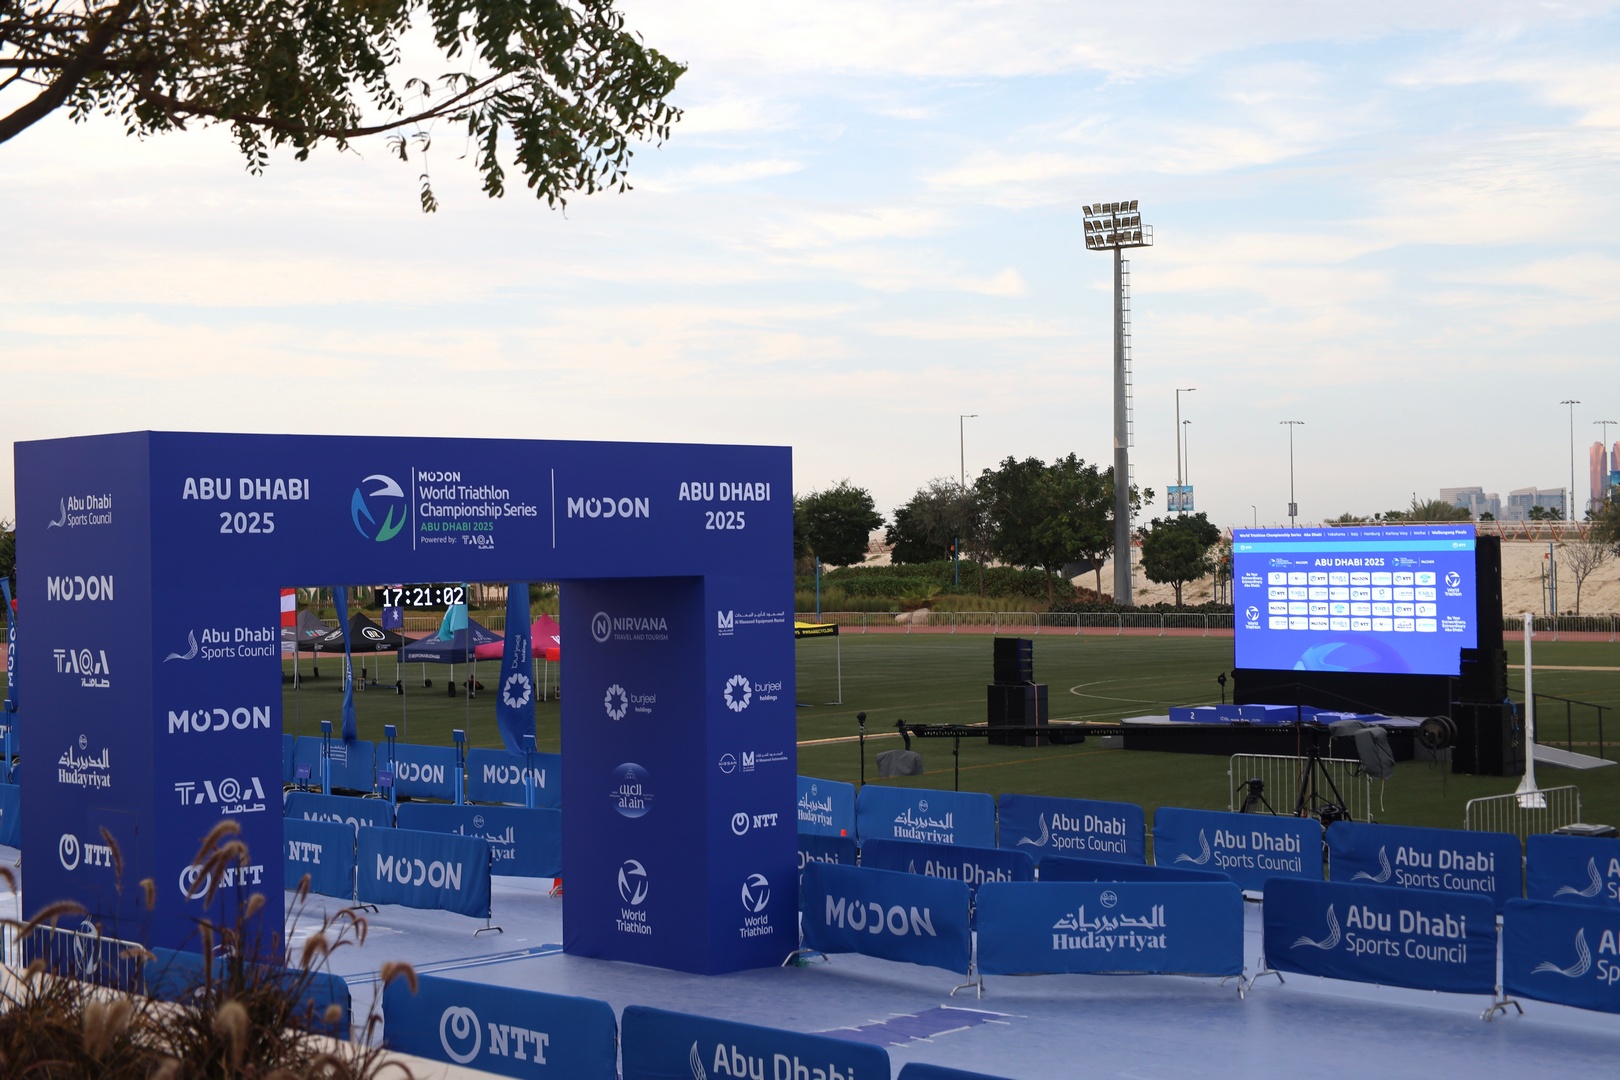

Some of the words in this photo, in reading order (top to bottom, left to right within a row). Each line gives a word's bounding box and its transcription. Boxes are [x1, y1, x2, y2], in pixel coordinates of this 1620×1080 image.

[182, 477, 231, 500] ABU
[240, 478, 310, 500] DHABI
[420, 485, 456, 500] World
[458, 486, 509, 500] Triathlon
[678, 482, 714, 501] ABU
[719, 482, 770, 501] DHABI
[67, 496, 84, 511] Abu
[87, 494, 112, 510] Dhabi
[420, 502, 502, 519] Championship
[504, 503, 537, 516] Series
[67, 514, 87, 528] Sports
[88, 512, 112, 525] Council
[220, 512, 274, 534] 2025
[421, 522, 440, 531] ABU
[442, 522, 471, 531] DHABI
[474, 522, 494, 531] 2025
[705, 511, 745, 530] 2025
[448, 536, 457, 544] by:
[1364, 558, 1385, 566] 2025
[383, 587, 463, 607] 17:21:02
[614, 617, 668, 631] NIRVANA
[201, 628, 229, 643] Abu
[234, 626, 274, 642] Dhabi
[201, 646, 235, 661] Sports
[238, 644, 274, 658] Council
[511, 634, 522, 669] burjeel
[54, 648, 110, 676] TAQA
[755, 681, 781, 693] burjeel
[631, 693, 656, 704] burjeel
[58, 768, 111, 790] Hudayriyat
[175, 777, 265, 805] TAQA
[619, 796, 627, 808] al
[628, 797, 645, 809] ain
[753, 814, 778, 828] NTT
[798, 809, 832, 826] Hudayriyat
[1052, 813, 1079, 832] Abu
[1084, 815, 1126, 836] Dhabi
[894, 826, 954, 844] Hudayriyat
[1052, 833, 1085, 850] Sports
[1088, 836, 1126, 854] Council
[1214, 830, 1246, 849] Abu
[1252, 832, 1300, 853] Dhabi
[84, 844, 112, 867] NTT
[288, 841, 322, 864] NTT
[1214, 852, 1254, 870] Sports
[1257, 854, 1301, 872] Council
[1395, 847, 1432, 868] Abu
[1439, 850, 1494, 872] Dhabi
[218, 865, 263, 888] NTT
[1395, 869, 1439, 889] Sports
[1444, 872, 1495, 892] Council
[621, 908, 646, 922] World
[744, 914, 768, 926] World
[1346, 905, 1391, 932] Abu
[1400, 910, 1466, 939] Dhabi
[616, 919, 651, 935] Triathlon
[740, 925, 773, 938] Triathlon
[1052, 931, 1167, 951] Hudayriyat
[1346, 933, 1399, 957] Sports
[1405, 939, 1467, 964] Council
[488, 1022, 549, 1065] NTT
[713, 1044, 763, 1078] Abu
[773, 1054, 854, 1080] Dhabi
